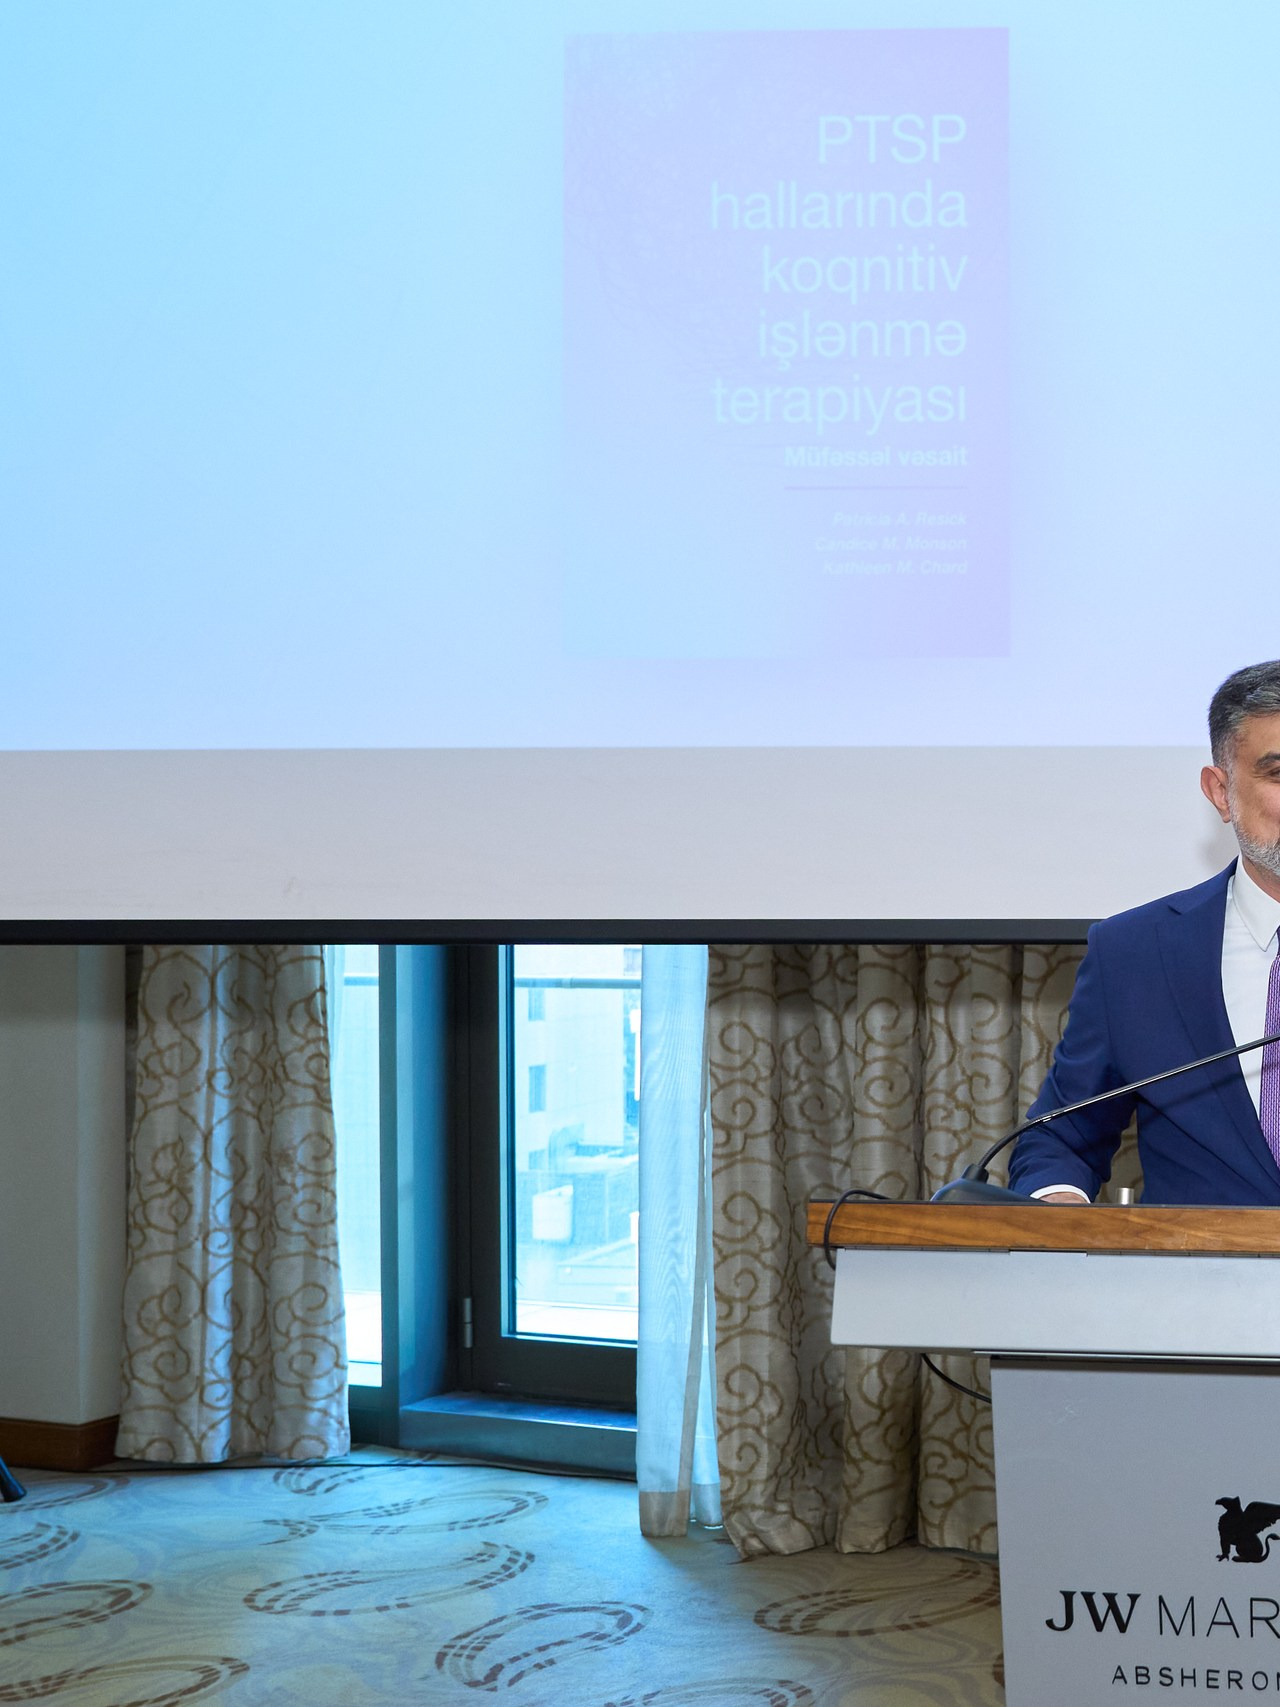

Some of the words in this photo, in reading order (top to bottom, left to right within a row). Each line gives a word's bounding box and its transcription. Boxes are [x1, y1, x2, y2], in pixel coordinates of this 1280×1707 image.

[818, 114, 966, 163] PTSP
[711, 178, 968, 229] hallarında
[763, 243, 968, 304] koqnitiv
[758, 308, 966, 371] işlənmə
[712, 374, 966, 435] terapiyası
[898, 446, 968, 466] vəsait
[1045, 1590, 1141, 1633] JW
